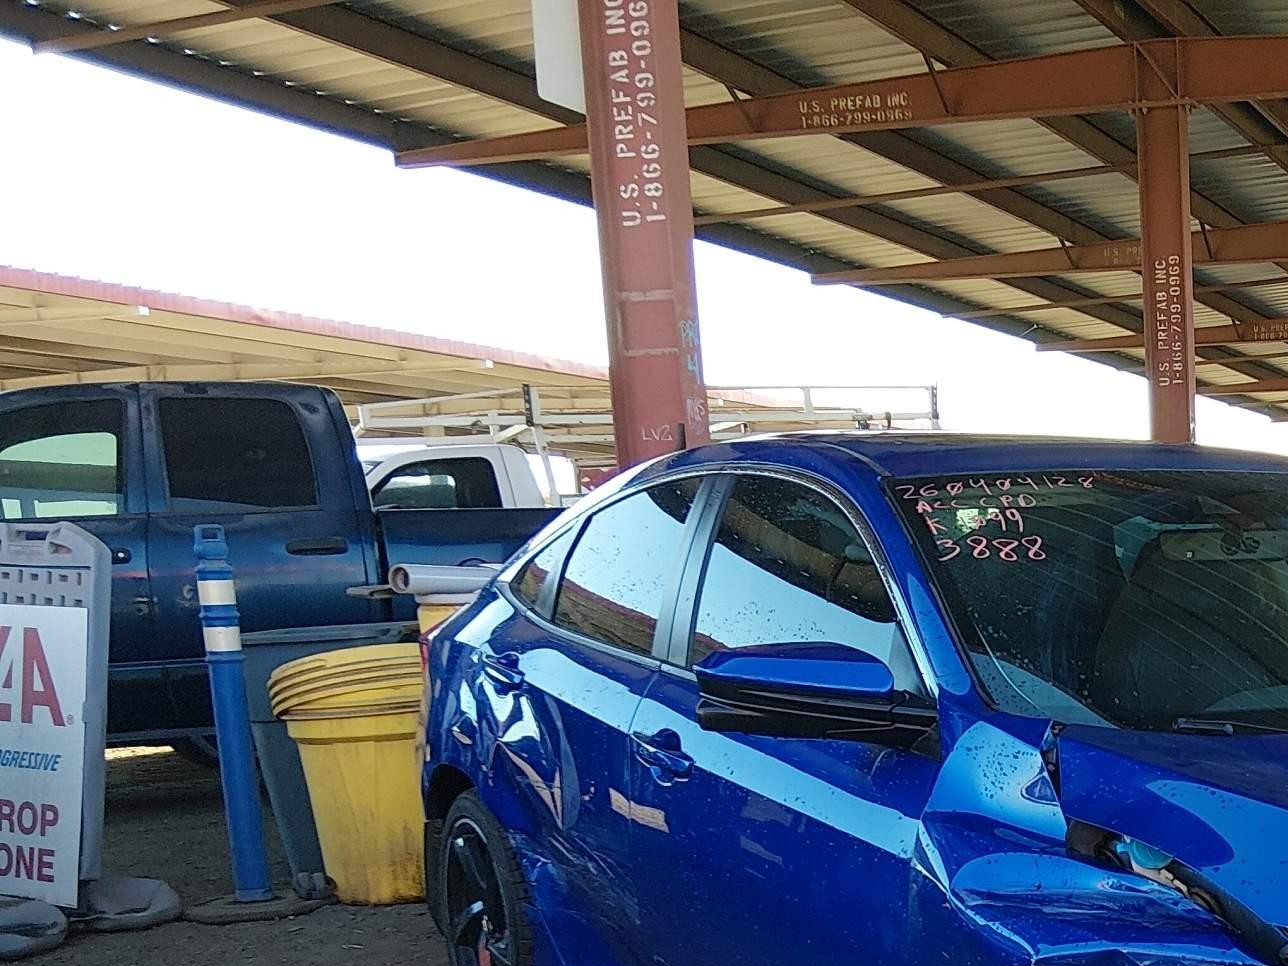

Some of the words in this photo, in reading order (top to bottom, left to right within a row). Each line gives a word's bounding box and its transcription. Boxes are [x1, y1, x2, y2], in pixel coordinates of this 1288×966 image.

[608, 48, 637, 158] PREFAB
[799, 100, 825, 114] U.S.
[831, 94, 881, 111] PREFAB
[620, 174, 642, 227] U.S.
[1156, 291, 1169, 350] PREFAB
[1168, 255, 1184, 384] 1-866-799-0969
[935, 535, 1047, 562] 3888
[0, 749, 61, 772] GRESSIVE
